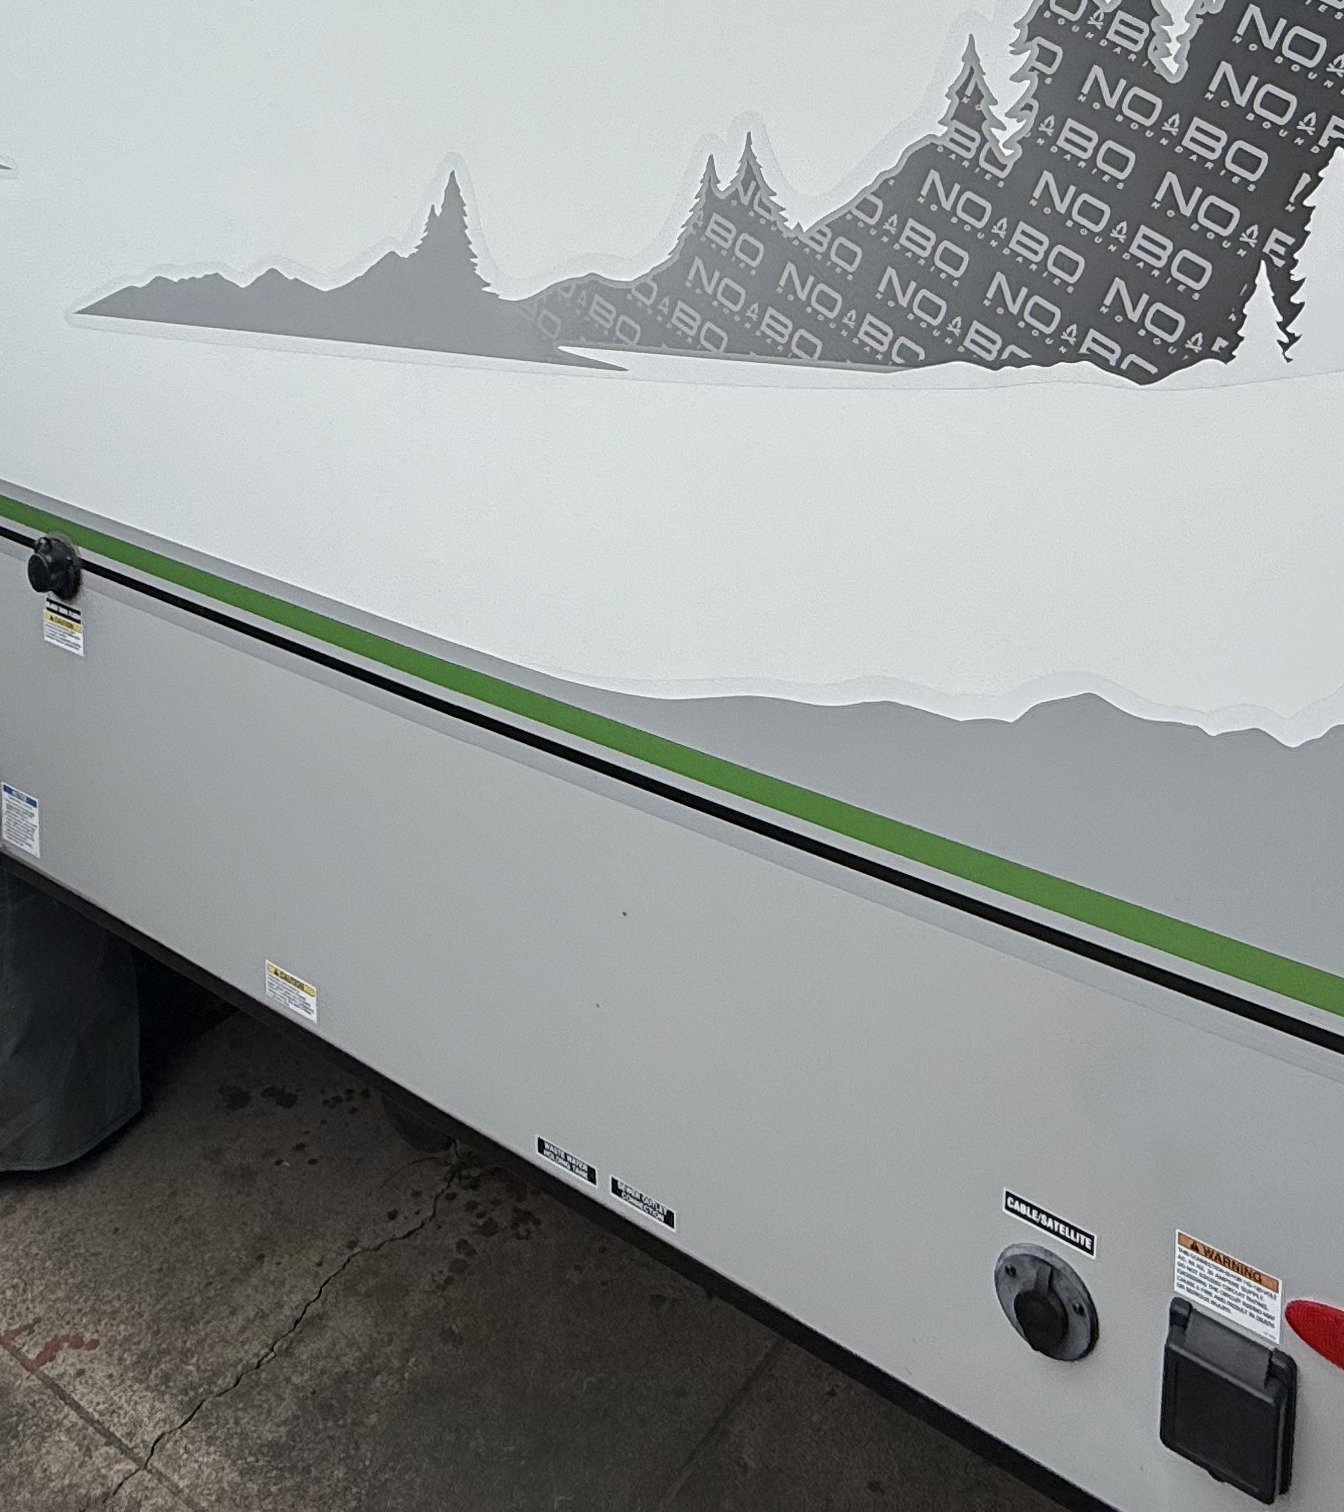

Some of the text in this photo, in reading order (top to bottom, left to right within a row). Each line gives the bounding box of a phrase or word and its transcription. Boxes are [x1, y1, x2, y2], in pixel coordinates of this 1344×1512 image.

[1237, 3, 1327, 68] NO
[1081, 64, 1269, 182] NO BO
[1208, 60, 1298, 126] NO
[1056, 118, 1136, 180] BO
[920, 169, 1085, 284] NO BO
[1032, 170, 1111, 233] NO
[1129, 225, 1213, 290] BO
[1155, 171, 1241, 237] NO
[899, 218, 970, 278] BO
[778, 261, 843, 319] NO
[878, 266, 947, 327] NO
[986, 271, 1062, 335] NO
[1103, 277, 1186, 343] NO
[1007, 1196, 1093, 1251] CABLE/SATELLITE
[1203, 1245, 1263, 1284] WARNING
